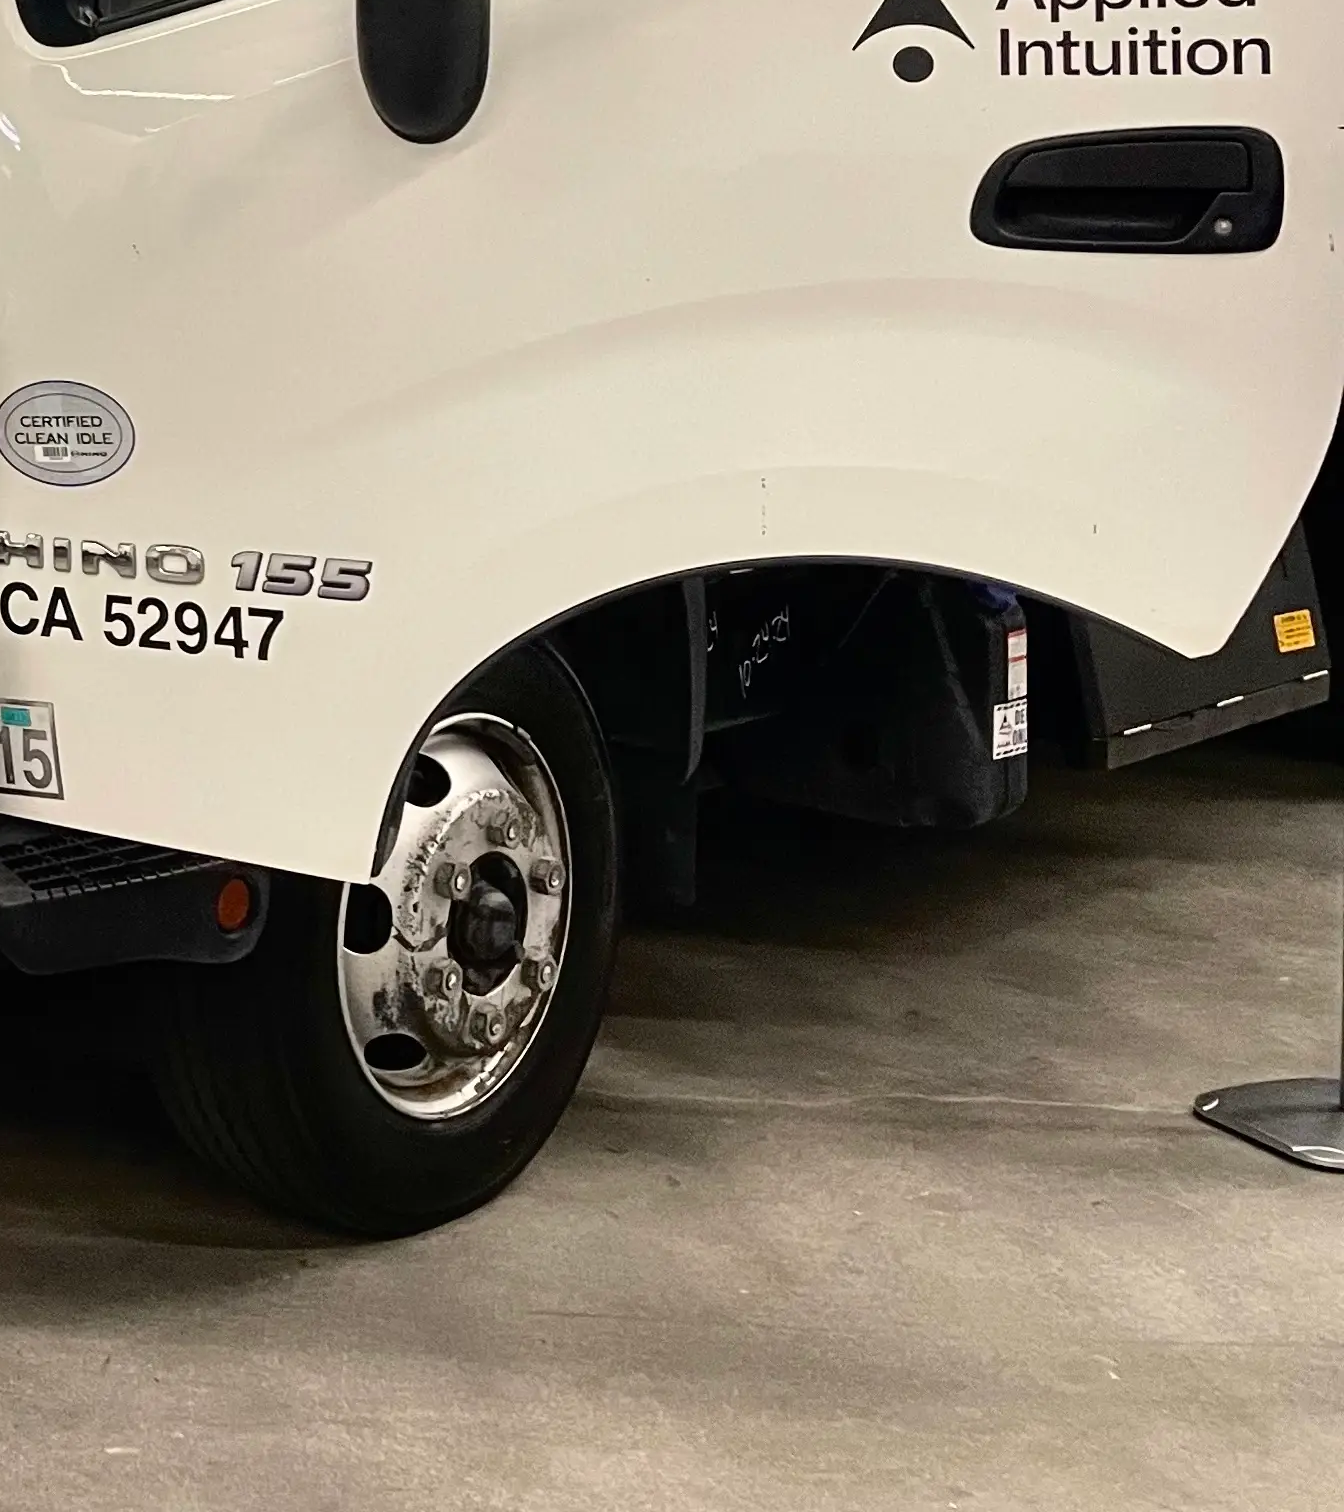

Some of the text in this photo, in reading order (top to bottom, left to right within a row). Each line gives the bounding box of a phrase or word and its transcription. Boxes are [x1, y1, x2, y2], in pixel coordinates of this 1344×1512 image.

[999, 26, 1271, 76] Intuition
[14, 432, 114, 445] CLEAN IDLE
[20, 415, 103, 428] CERTIFIED
[230, 550, 373, 602] 155
[0, 582, 284, 661] CA 52947
